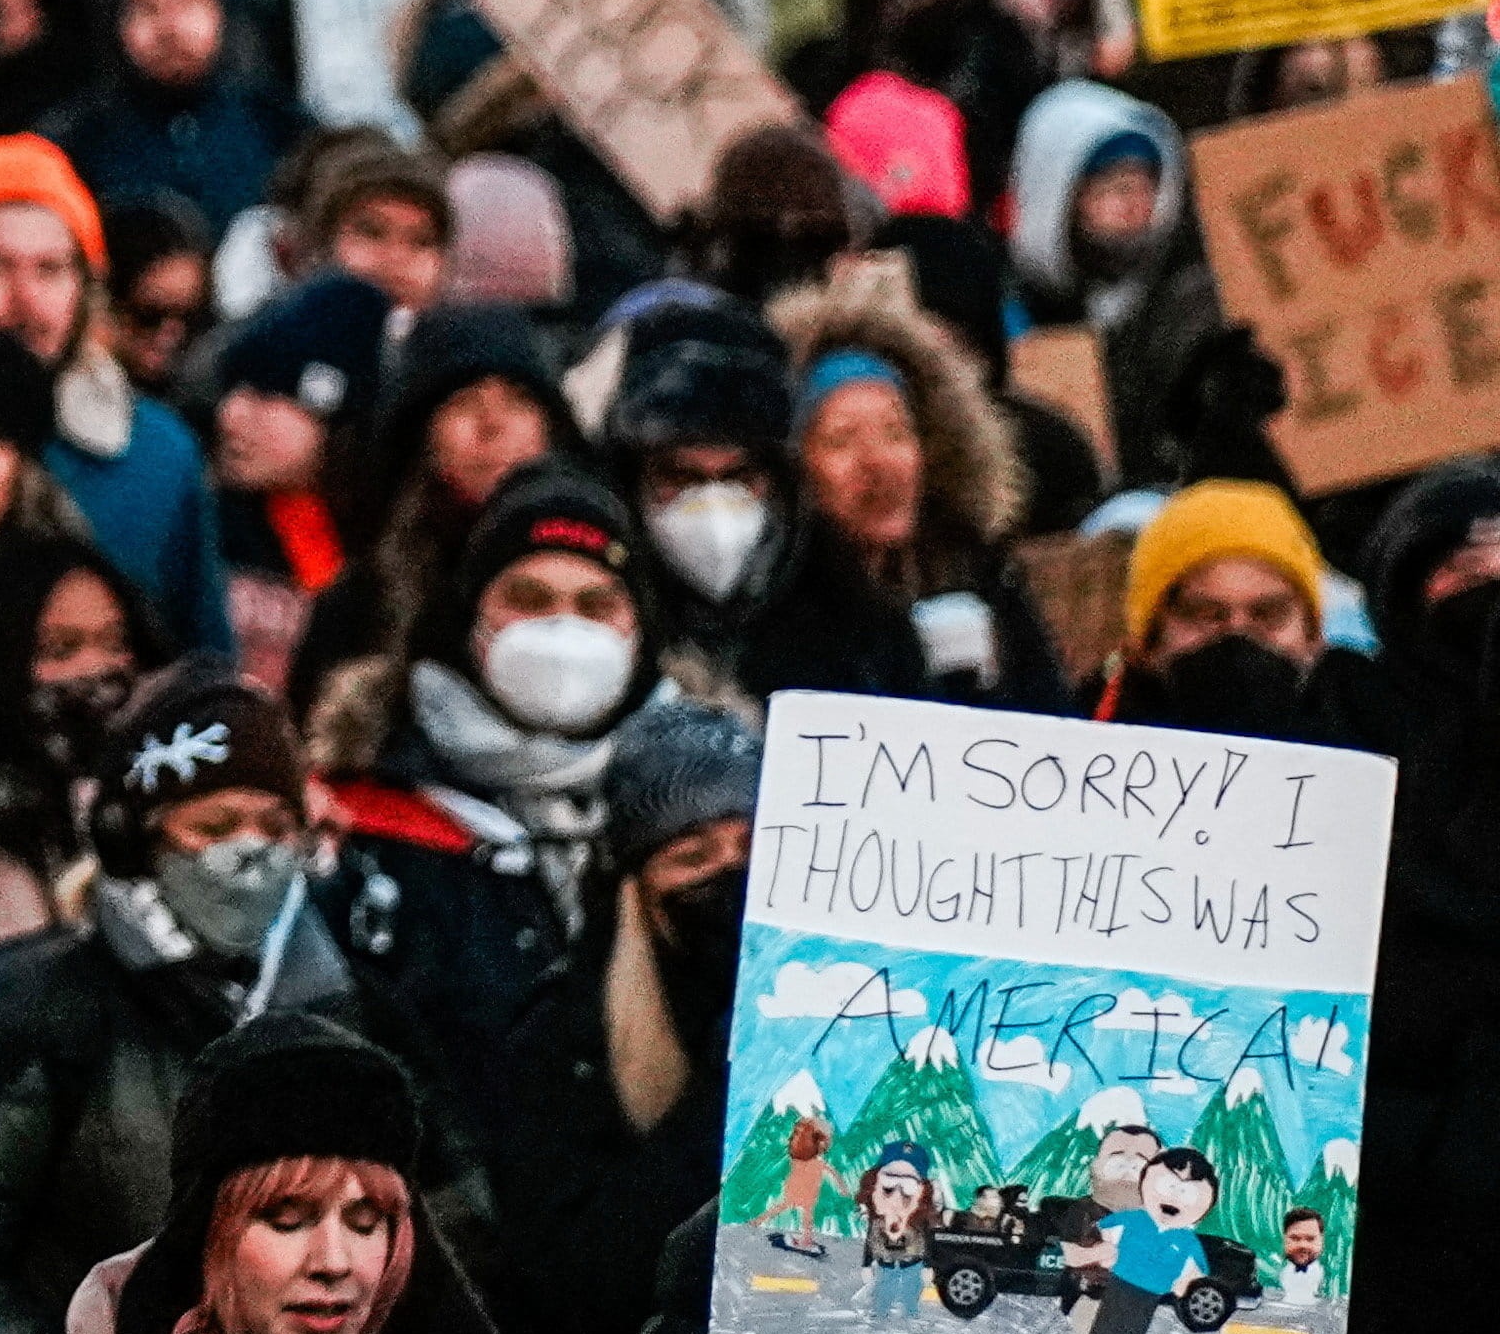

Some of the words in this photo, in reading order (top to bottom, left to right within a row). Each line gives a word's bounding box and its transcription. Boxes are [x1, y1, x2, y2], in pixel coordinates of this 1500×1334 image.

[1231, 124, 1500, 302] FUCK
[798, 722, 936, 810] I'M
[1274, 773, 1317, 850] I
[761, 818, 1045, 929] THOUGHT
[1049, 852, 1173, 938] THIS
[1192, 873, 1321, 950] WAS
